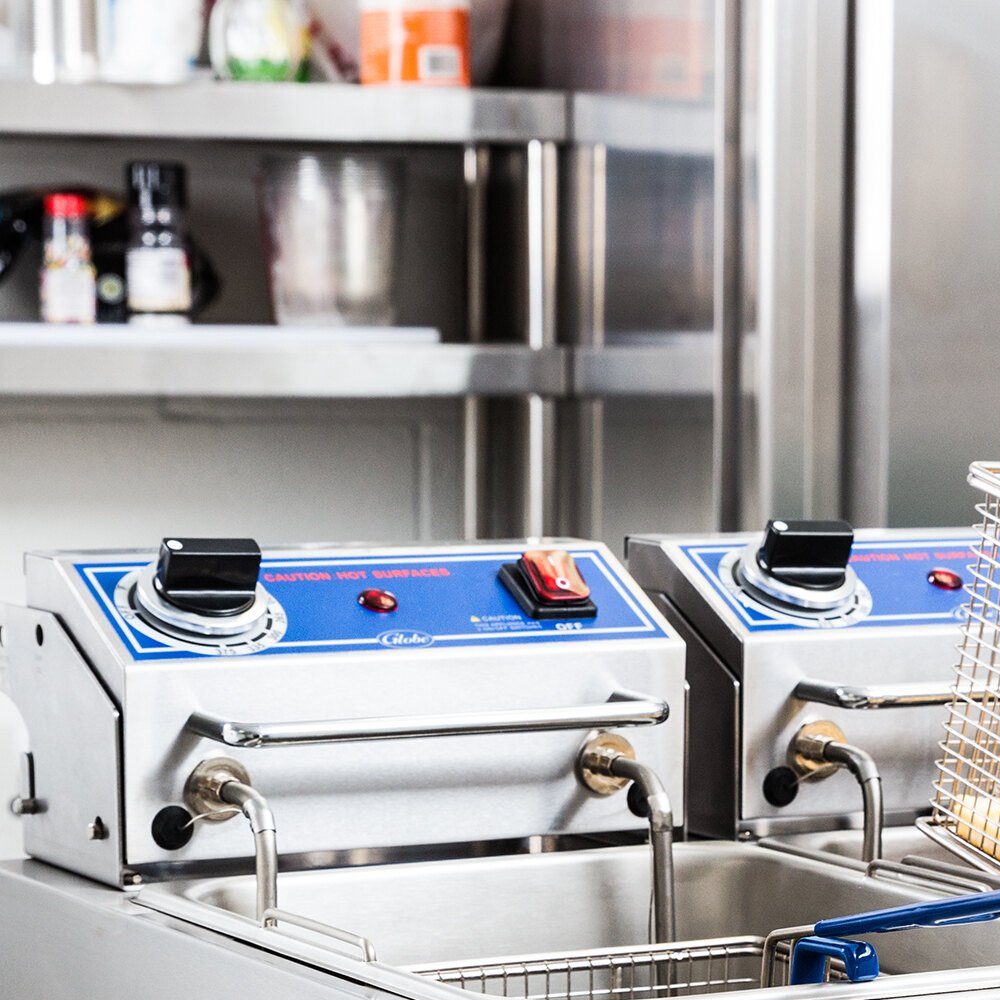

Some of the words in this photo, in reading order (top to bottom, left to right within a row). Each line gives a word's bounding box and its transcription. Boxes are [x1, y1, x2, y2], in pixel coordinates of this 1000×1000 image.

[263, 572, 331, 583] CAUTION
[336, 570, 368, 580] HOT
[371, 567, 451, 579] SURFACES
[555, 622, 583, 631] OFF
[381, 631, 430, 645] Globe
